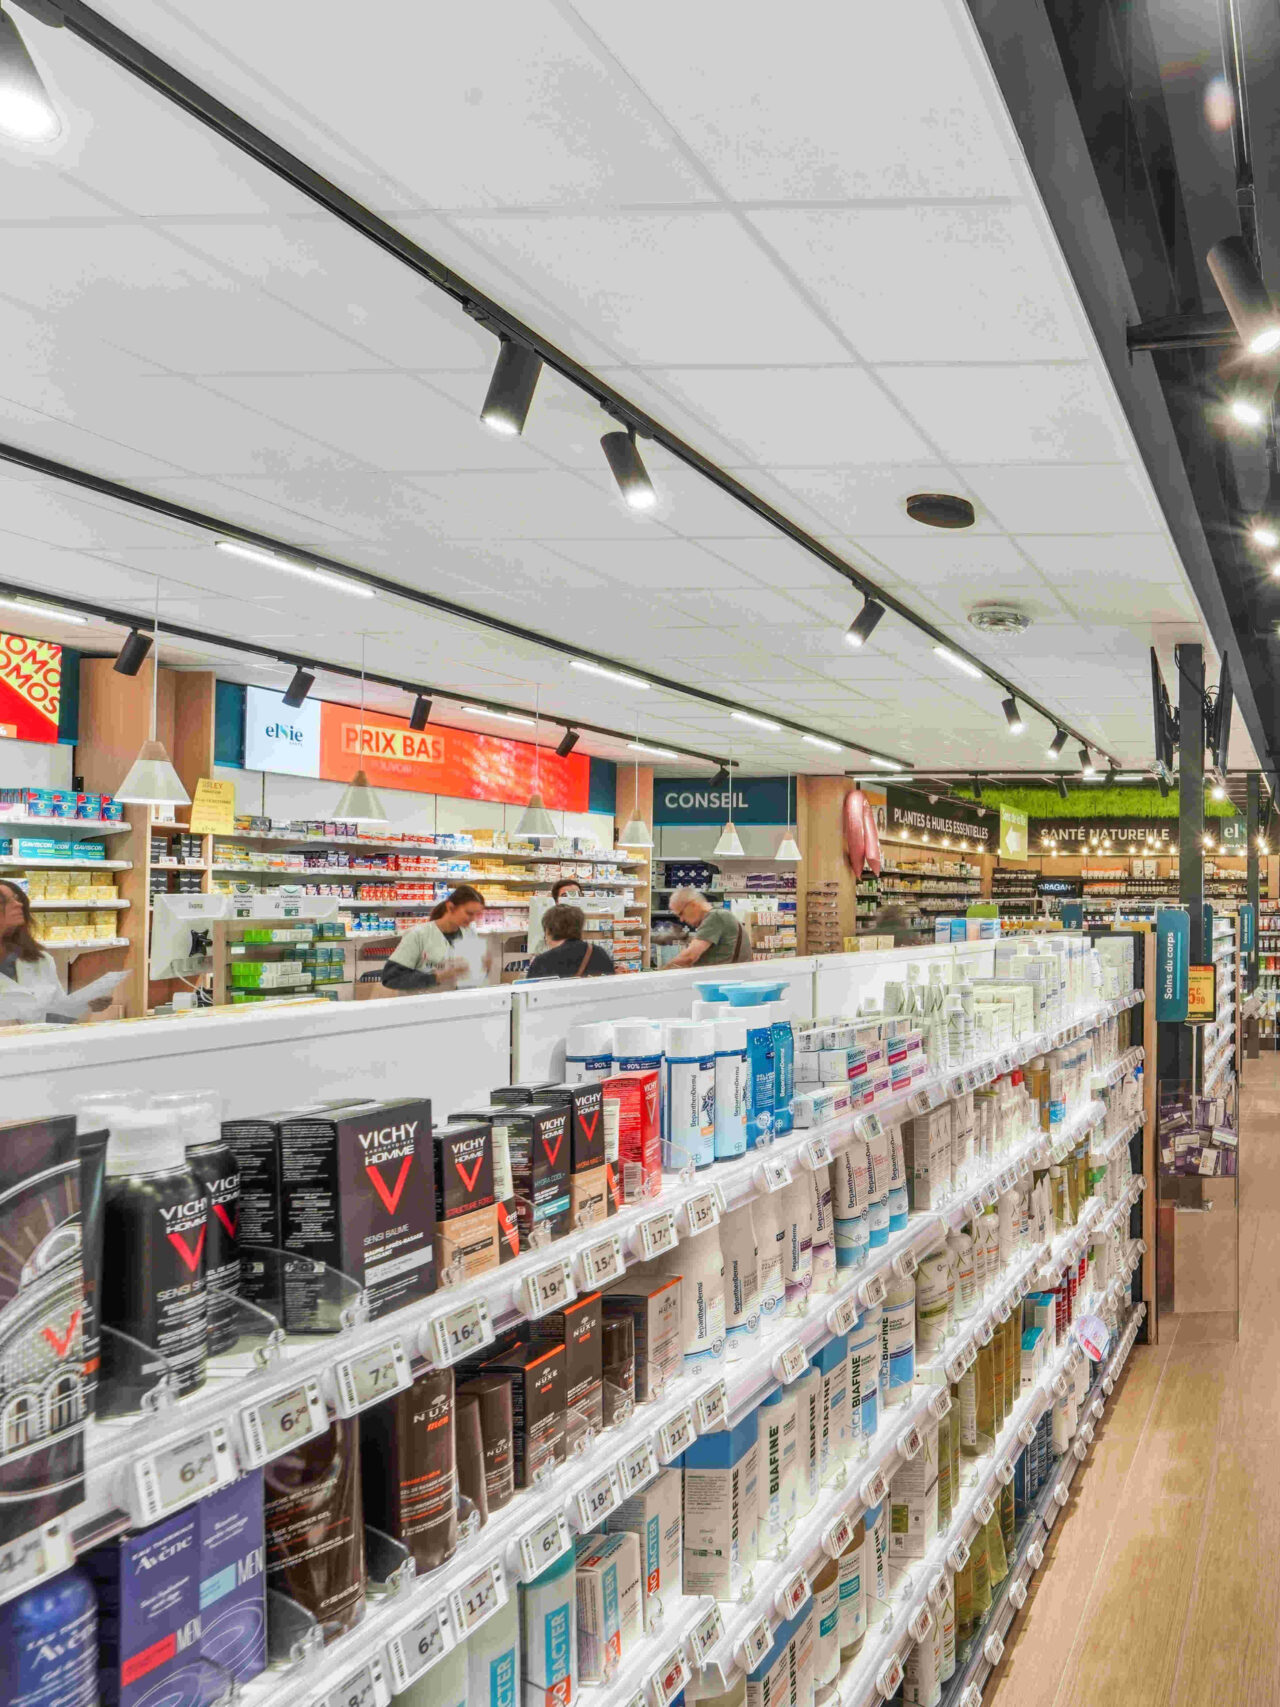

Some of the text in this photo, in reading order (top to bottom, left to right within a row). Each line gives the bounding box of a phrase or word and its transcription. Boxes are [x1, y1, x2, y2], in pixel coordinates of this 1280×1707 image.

[345, 727, 442, 760] PRIX BAS
[665, 792, 749, 809] CONSEIL
[894, 808, 989, 840] PLANTES & HUILES ESSENTIELLES
[1040, 826, 1171, 841] SANTÉ NATURELLE
[1164, 931, 1176, 1000] Soins du corps
[574, 1091, 602, 1107] VICHY
[577, 1104, 601, 1116] HOMME
[539, 1115, 567, 1132] VICHY
[358, 1121, 419, 1150] VICHY
[541, 1129, 565, 1140] HOMME
[450, 1136, 487, 1155] VICHY
[364, 1144, 415, 1167] HOMME
[454, 1151, 484, 1164] HOMME
[363, 1232, 385, 1247] SENSI
[573, 1319, 597, 1337] NUXE
[535, 1369, 559, 1388] NUXE
[851, 1354, 861, 1439] CICABIAFINE
[427, 1416, 449, 1432] men
[135, 1535, 193, 1576] Avène
